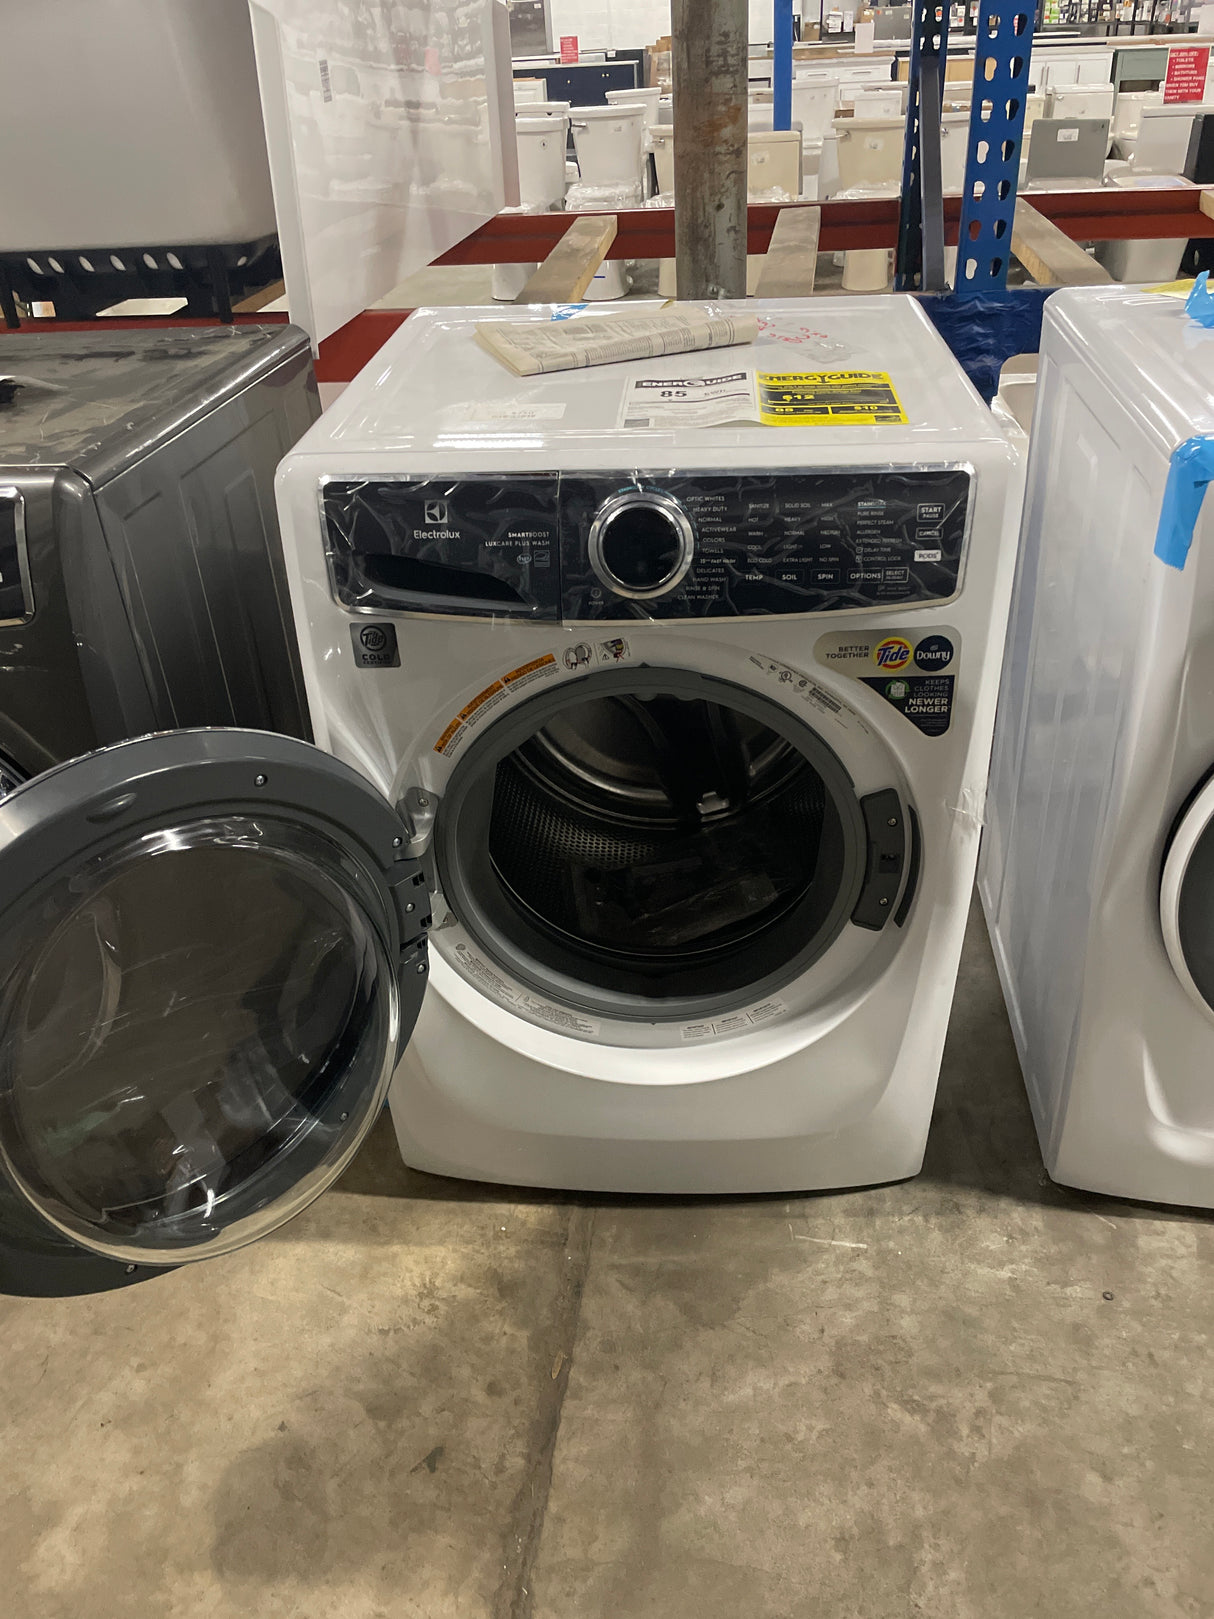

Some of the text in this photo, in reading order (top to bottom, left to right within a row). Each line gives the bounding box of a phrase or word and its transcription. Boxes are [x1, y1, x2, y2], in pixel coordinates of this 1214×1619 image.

[413, 529, 461, 540] Electrolux
[362, 653, 390, 661] COLD
[878, 645, 910, 666] Tide
[916, 651, 951, 662] Downy
[905, 705, 949, 713] LONGER
